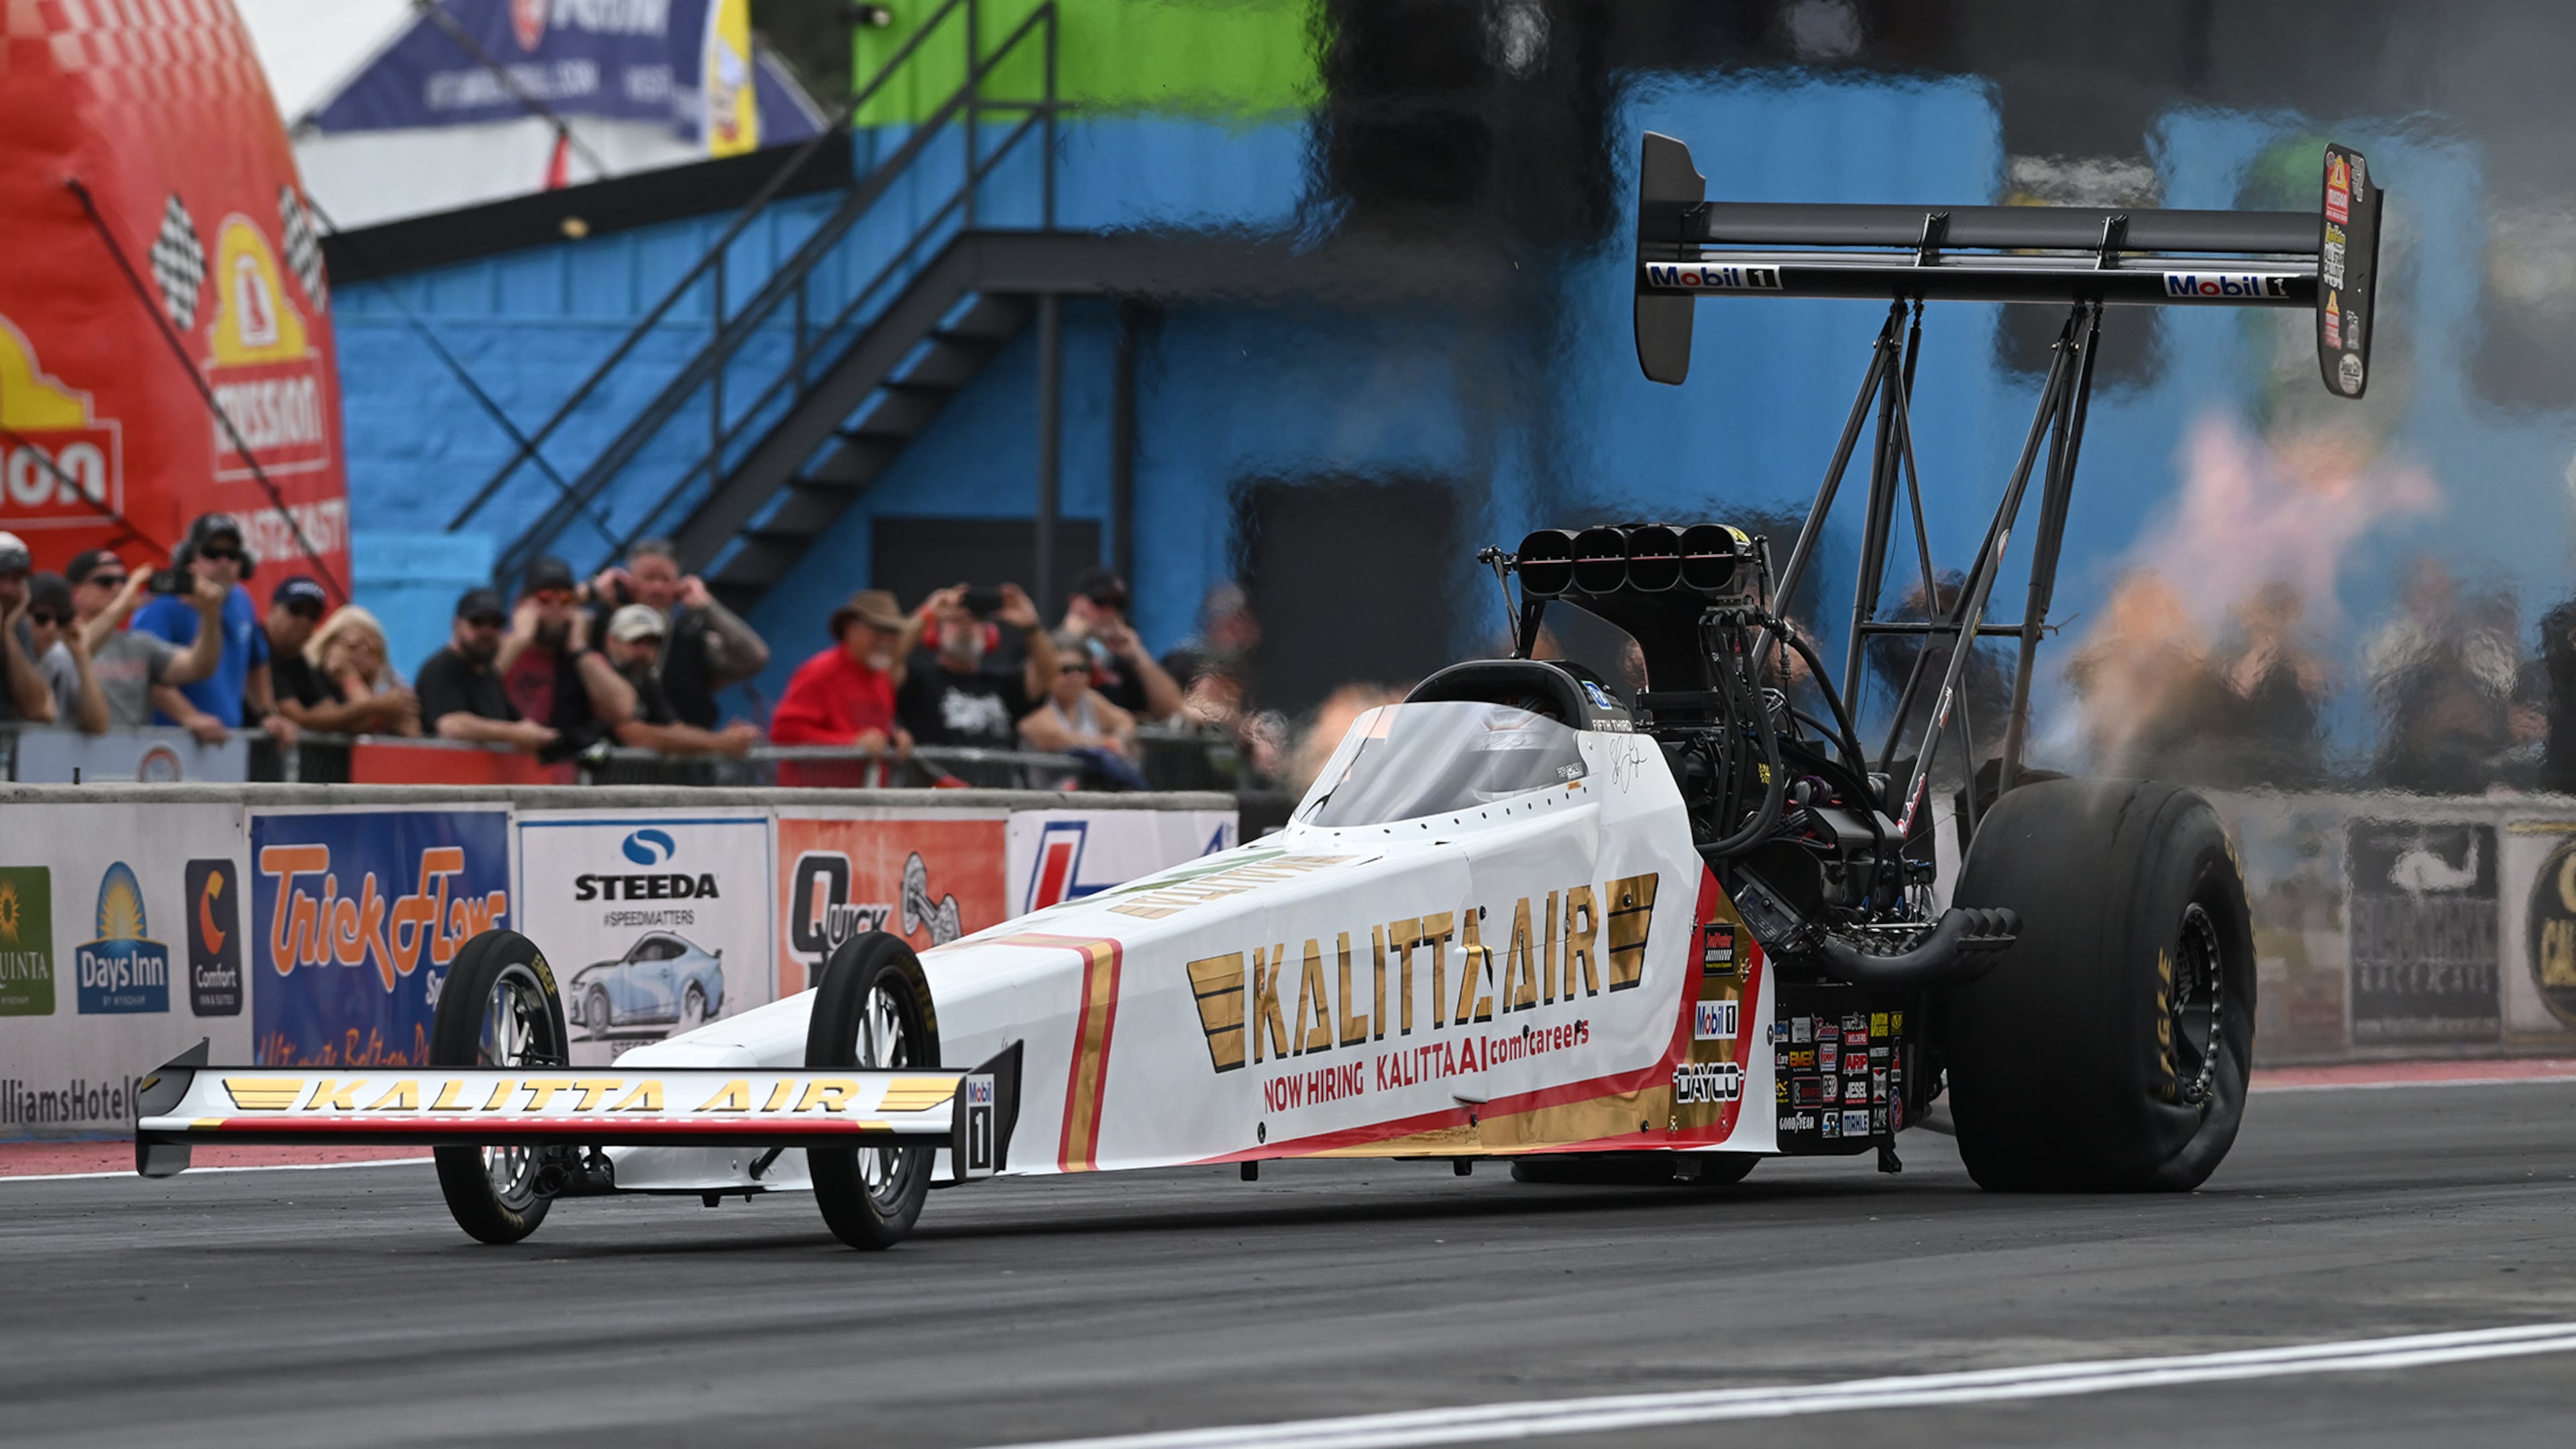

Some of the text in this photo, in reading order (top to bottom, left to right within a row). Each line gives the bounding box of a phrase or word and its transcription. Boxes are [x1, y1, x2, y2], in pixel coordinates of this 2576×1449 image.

[1650, 266, 1768, 287] Mobil 1
[2167, 275, 2261, 296] Mobil
[1592, 719, 1633, 732] FIFTH THIRD
[575, 873, 720, 900] STEEDA
[260, 843, 506, 993] Trick Flow
[604, 910, 695, 926] #SPEEDMATTERS
[0, 951, 50, 989] UINTA
[81, 950, 164, 993] Days Inn
[195, 963, 237, 989] Comfort
[1254, 884, 1600, 1065] KALITTA AIR
[1696, 1006, 1724, 1035] Mobil
[1845, 1053, 1867, 1070] ARP
[303, 1079, 860, 1112] KALITTA AIR
[968, 1081, 992, 1102] Mobil
[1264, 1076, 1303, 1114] NOW
[1307, 1061, 1364, 1106] HIRING
[1677, 1063, 1740, 1103] DAYCO
[2, 1075, 144, 1124] lliamsHotel
[1779, 1112, 1814, 1133] GOODYEAR
[1844, 1114, 1868, 1132] MAHLE
[974, 1111, 985, 1164] 1
